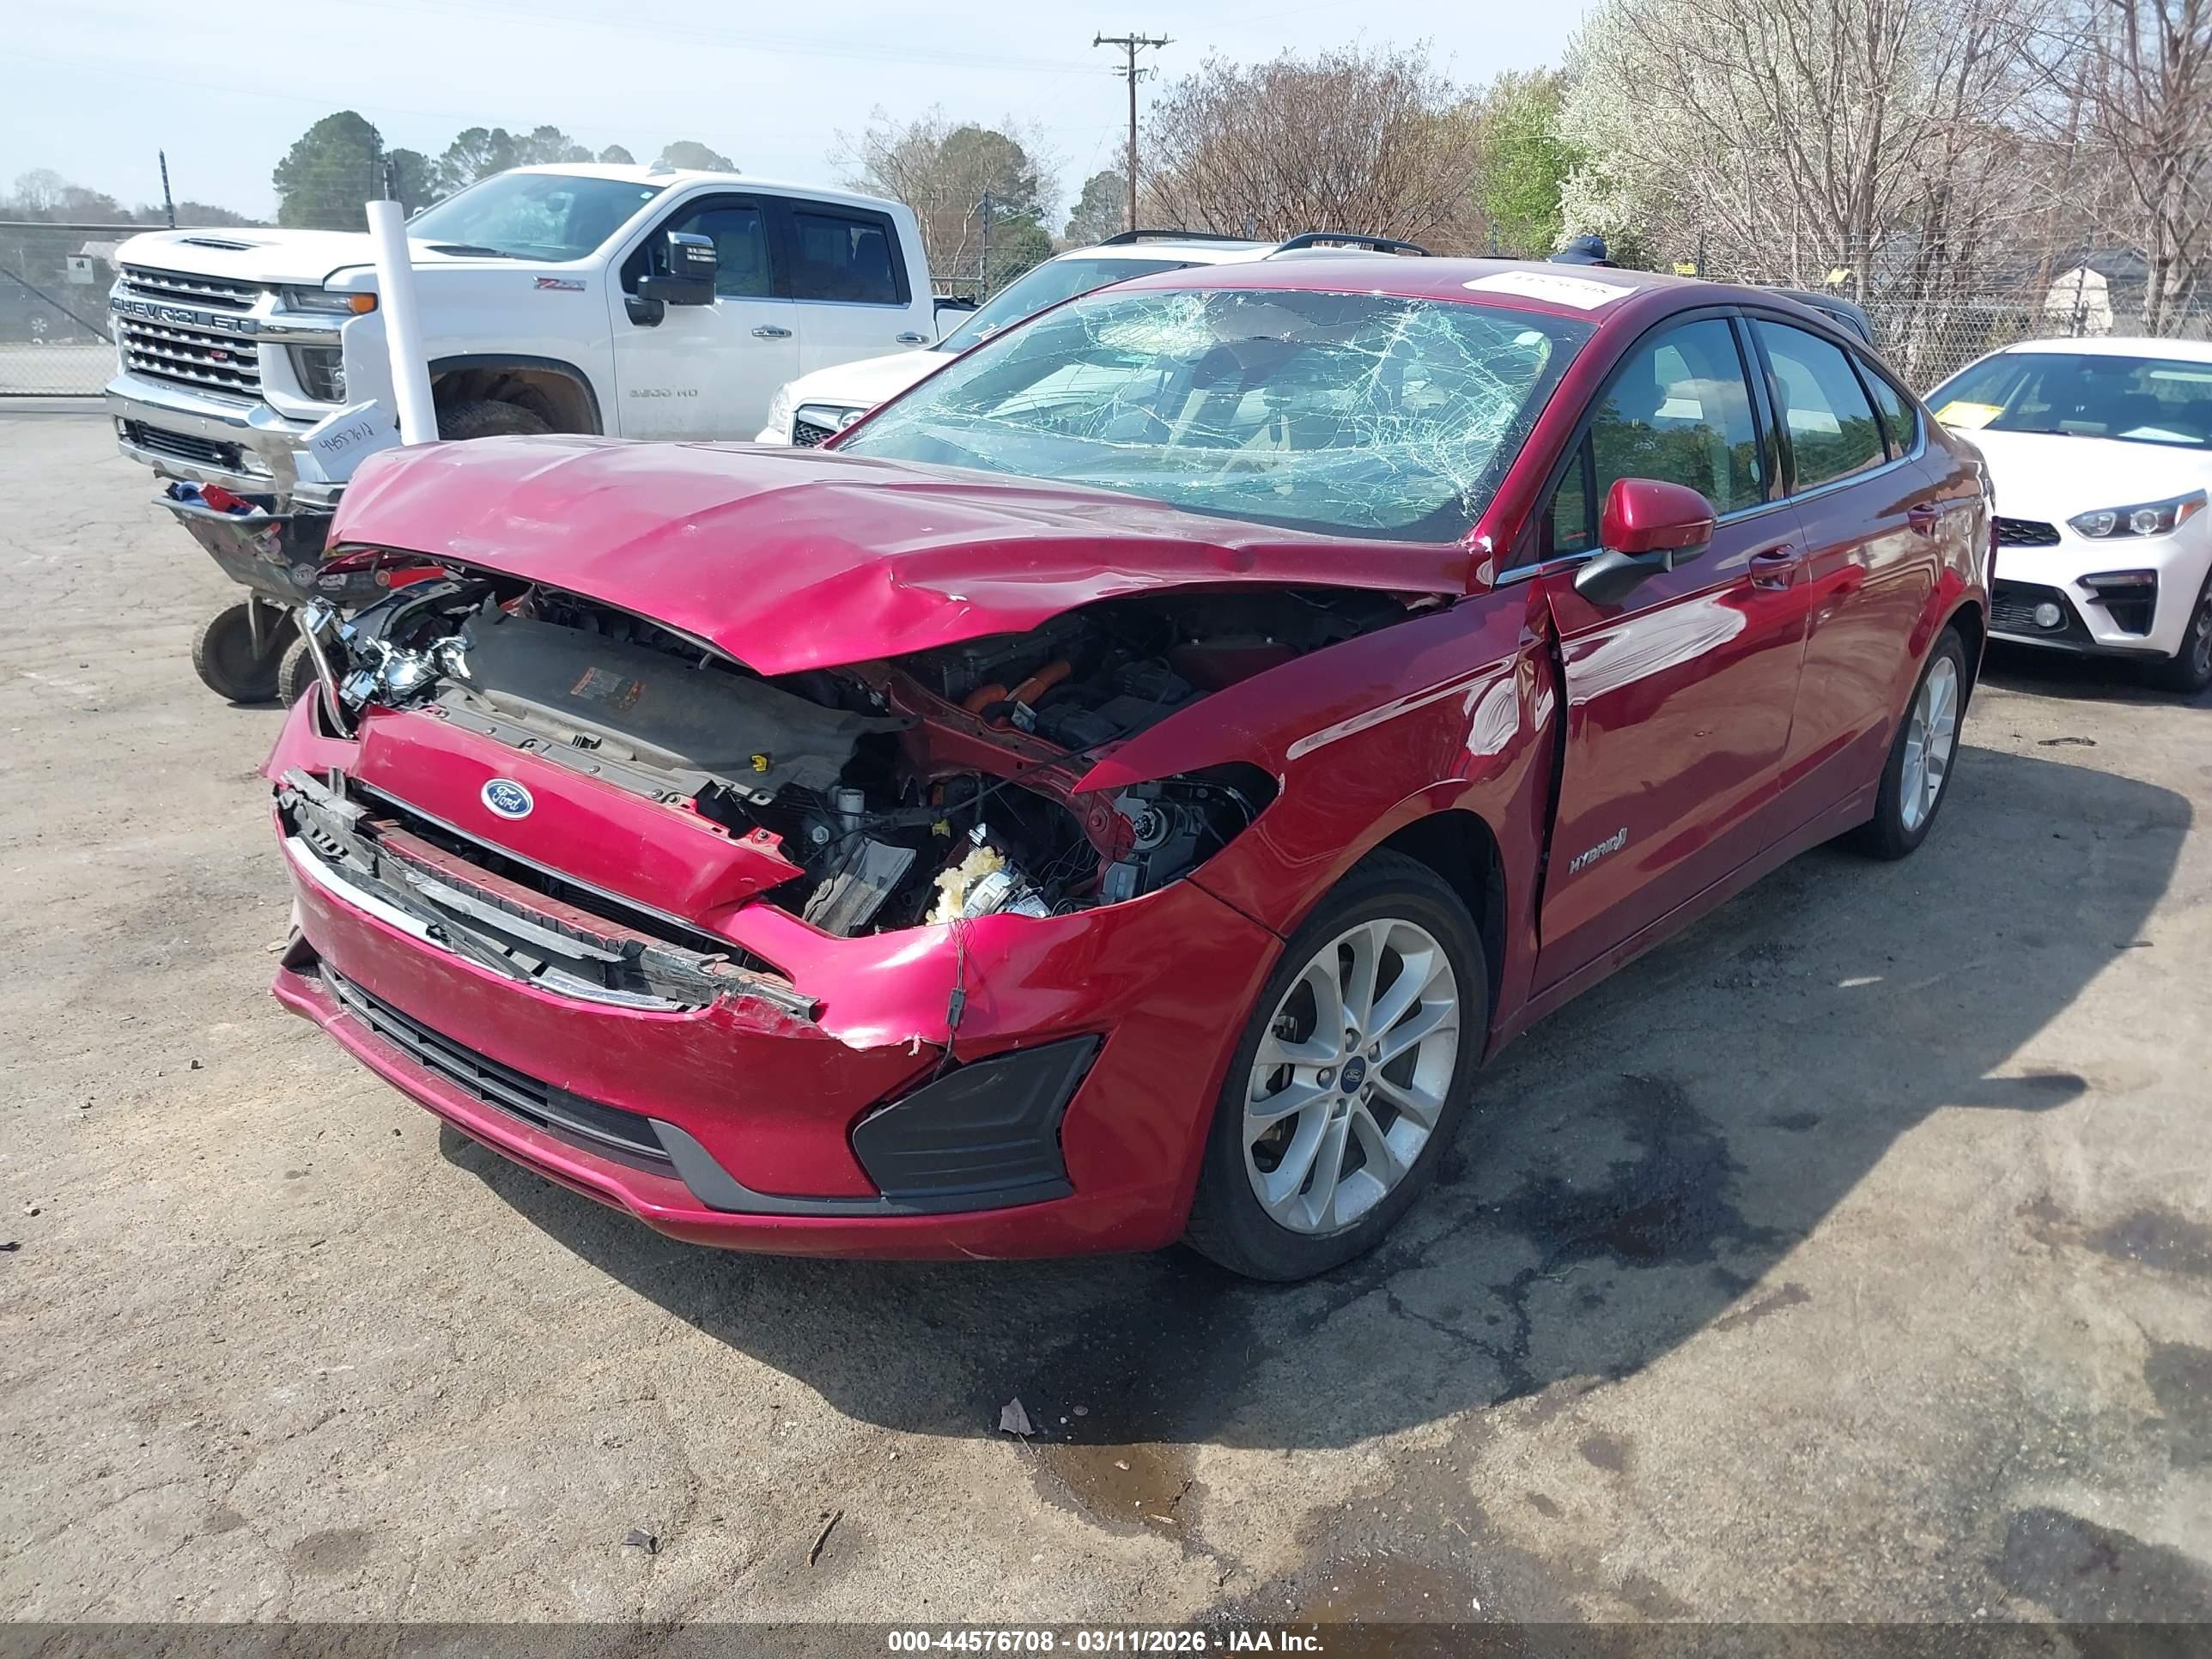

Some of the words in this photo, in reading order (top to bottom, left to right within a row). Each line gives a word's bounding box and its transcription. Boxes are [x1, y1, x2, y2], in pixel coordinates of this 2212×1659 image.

[111, 297, 258, 334] CHEVROLET
[492, 786, 522, 811] Ford
[1569, 836, 1618, 874] HYBRID
